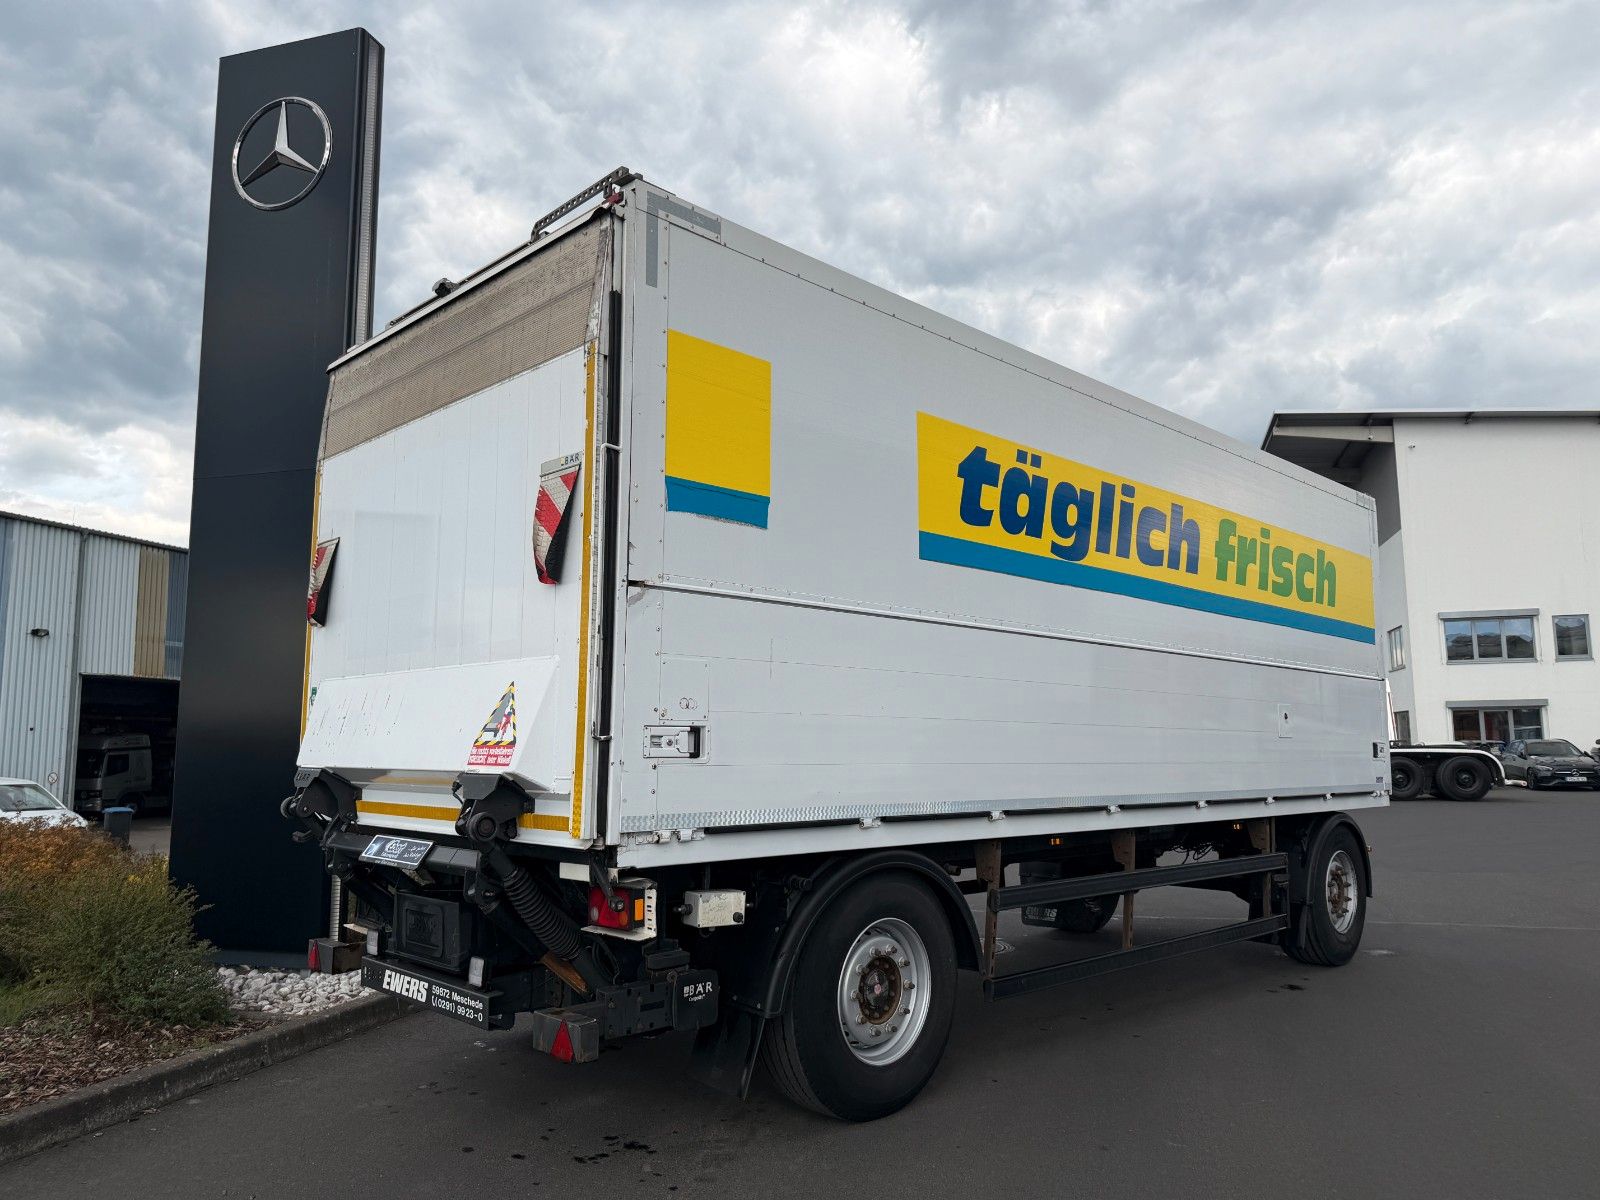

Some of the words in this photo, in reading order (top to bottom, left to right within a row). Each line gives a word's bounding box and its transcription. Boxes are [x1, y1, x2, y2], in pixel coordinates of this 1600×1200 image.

[957, 445, 1200, 575] täglich
[1214, 518, 1337, 608] frisch
[383, 969, 428, 1003] EWERS
[431, 985, 451, 999] 59872
[451, 991, 484, 1010] Meschede
[689, 981, 713, 995] BÄR
